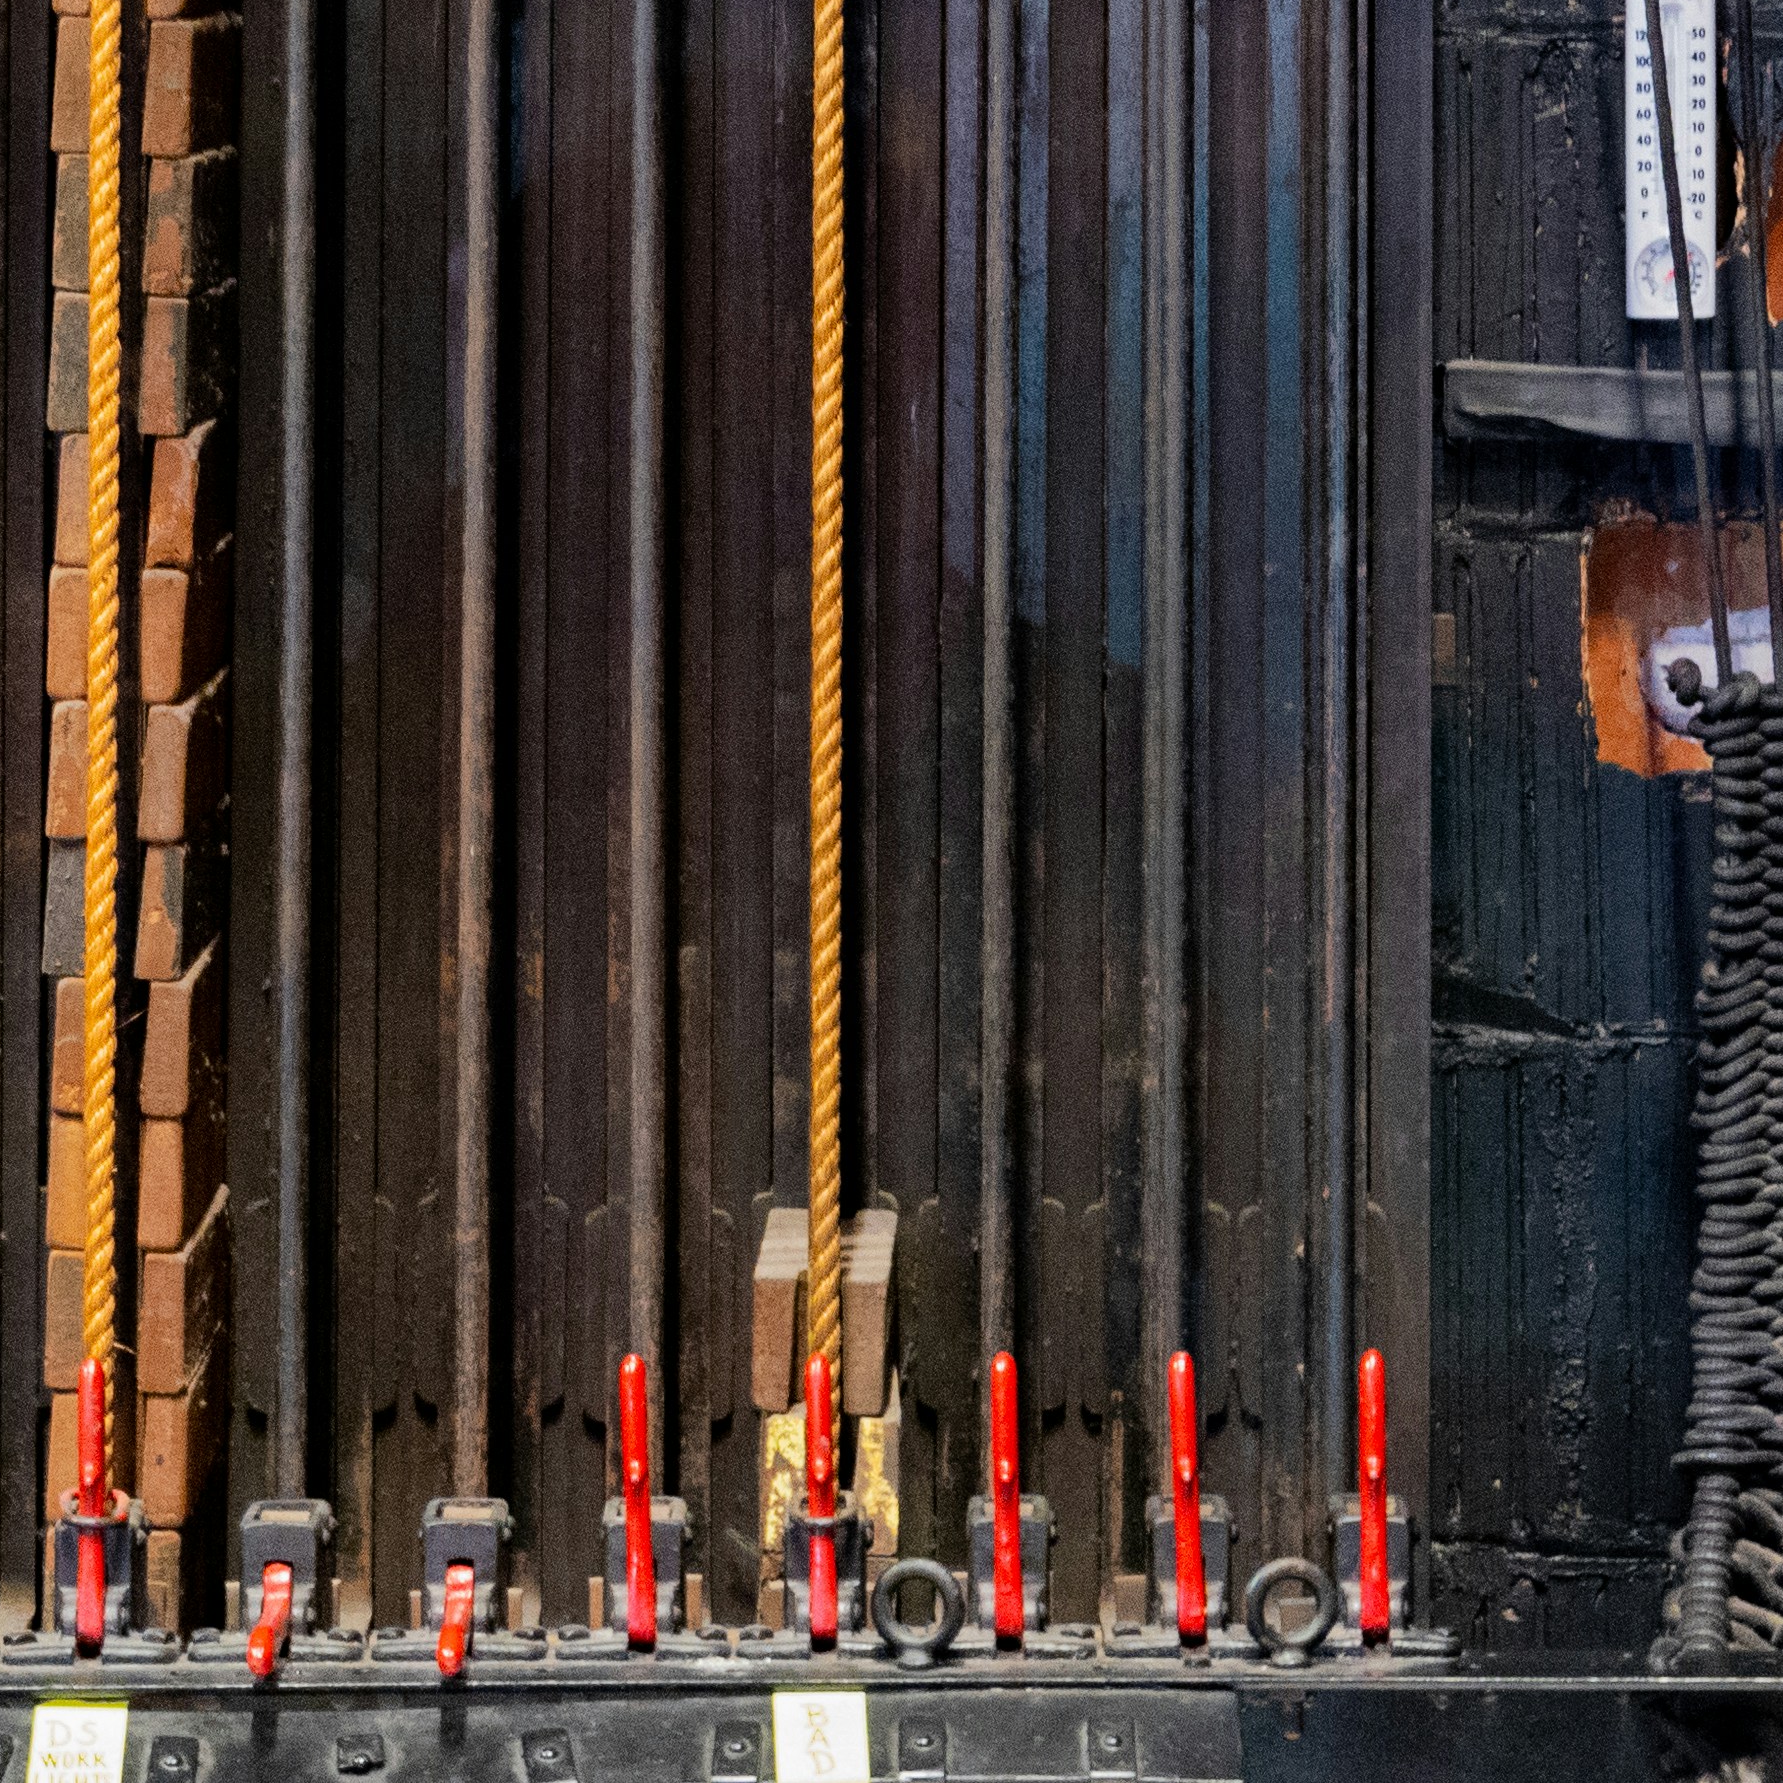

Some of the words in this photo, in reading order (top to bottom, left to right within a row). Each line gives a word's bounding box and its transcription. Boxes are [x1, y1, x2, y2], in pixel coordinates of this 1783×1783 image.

[1635, 30, 1648, 41] 12
[1692, 27, 1706, 39] 50
[1691, 51, 1706, 63] 40
[1636, 82, 1651, 93] 80
[1692, 98, 1706, 109] 20
[1636, 109, 1651, 120] 60
[1692, 122, 1705, 133] 10
[1637, 135, 1652, 146] 40
[1695, 145, 1702, 156] 0
[1637, 161, 1652, 172] 20
[1641, 187, 1648, 198] 0
[1641, 211, 1649, 219] F
[46, 1719, 100, 1748] DS
[39, 1751, 108, 1769] WORK
